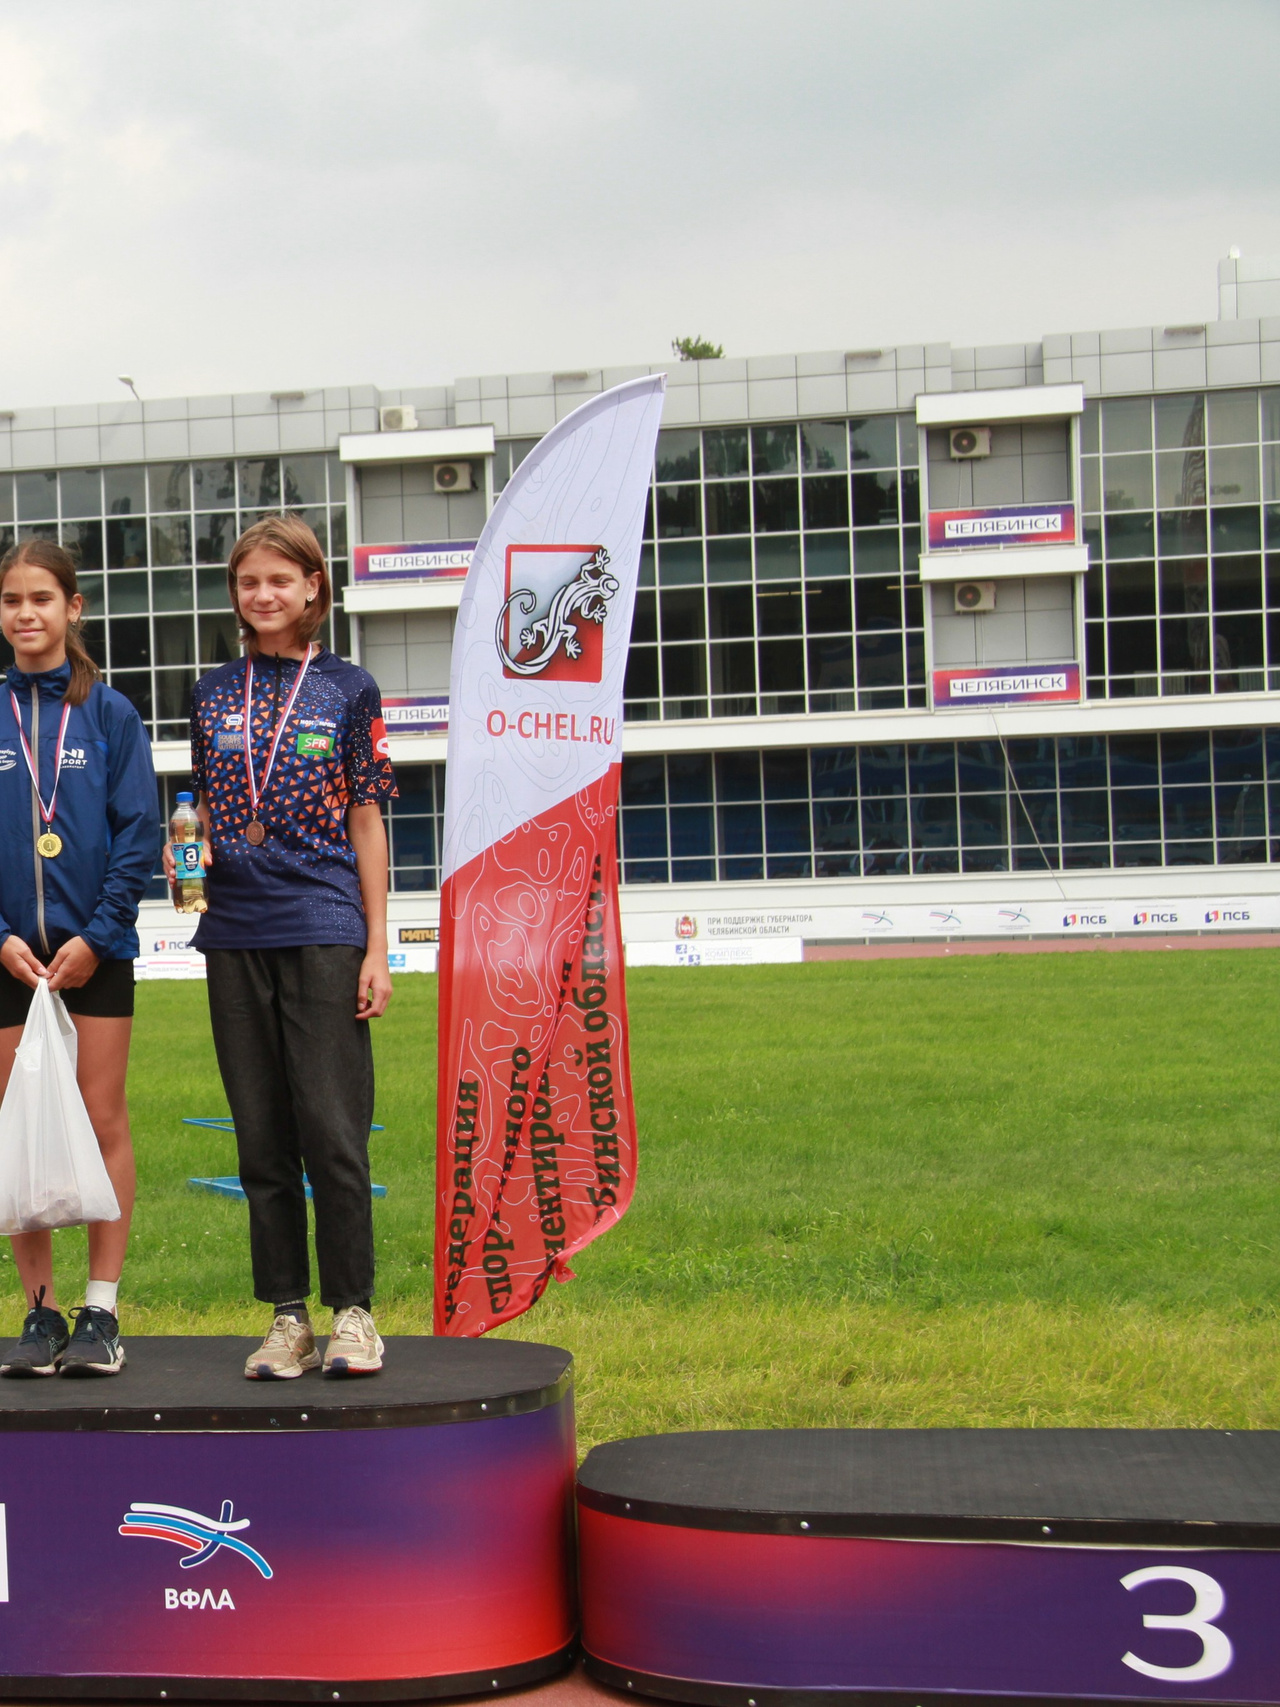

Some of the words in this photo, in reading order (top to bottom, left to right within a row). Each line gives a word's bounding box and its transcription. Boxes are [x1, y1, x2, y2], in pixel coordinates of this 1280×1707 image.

[948, 517, 1059, 534] ЧЕЛЯБИНСК
[953, 676, 1063, 693] ЧЕЛЯБИНСК
[486, 709, 615, 745] O-CHEL.RU
[305, 737, 327, 749] SFR
[723, 916, 765, 925] ПОДДЕРЖКЕ
[767, 915, 812, 923] ГУБЕРНАТОРА
[1080, 915, 1107, 925] ПСБ
[1151, 913, 1178, 923] ПСБ
[1223, 911, 1250, 921] ПСБ
[708, 925, 757, 935] ЧЕЛЯБИНСКОЙ
[760, 926, 790, 934] ОБЛАСТИ
[165, 1588, 236, 1610] ВФЛА
[1120, 1566, 1232, 1682] 3
